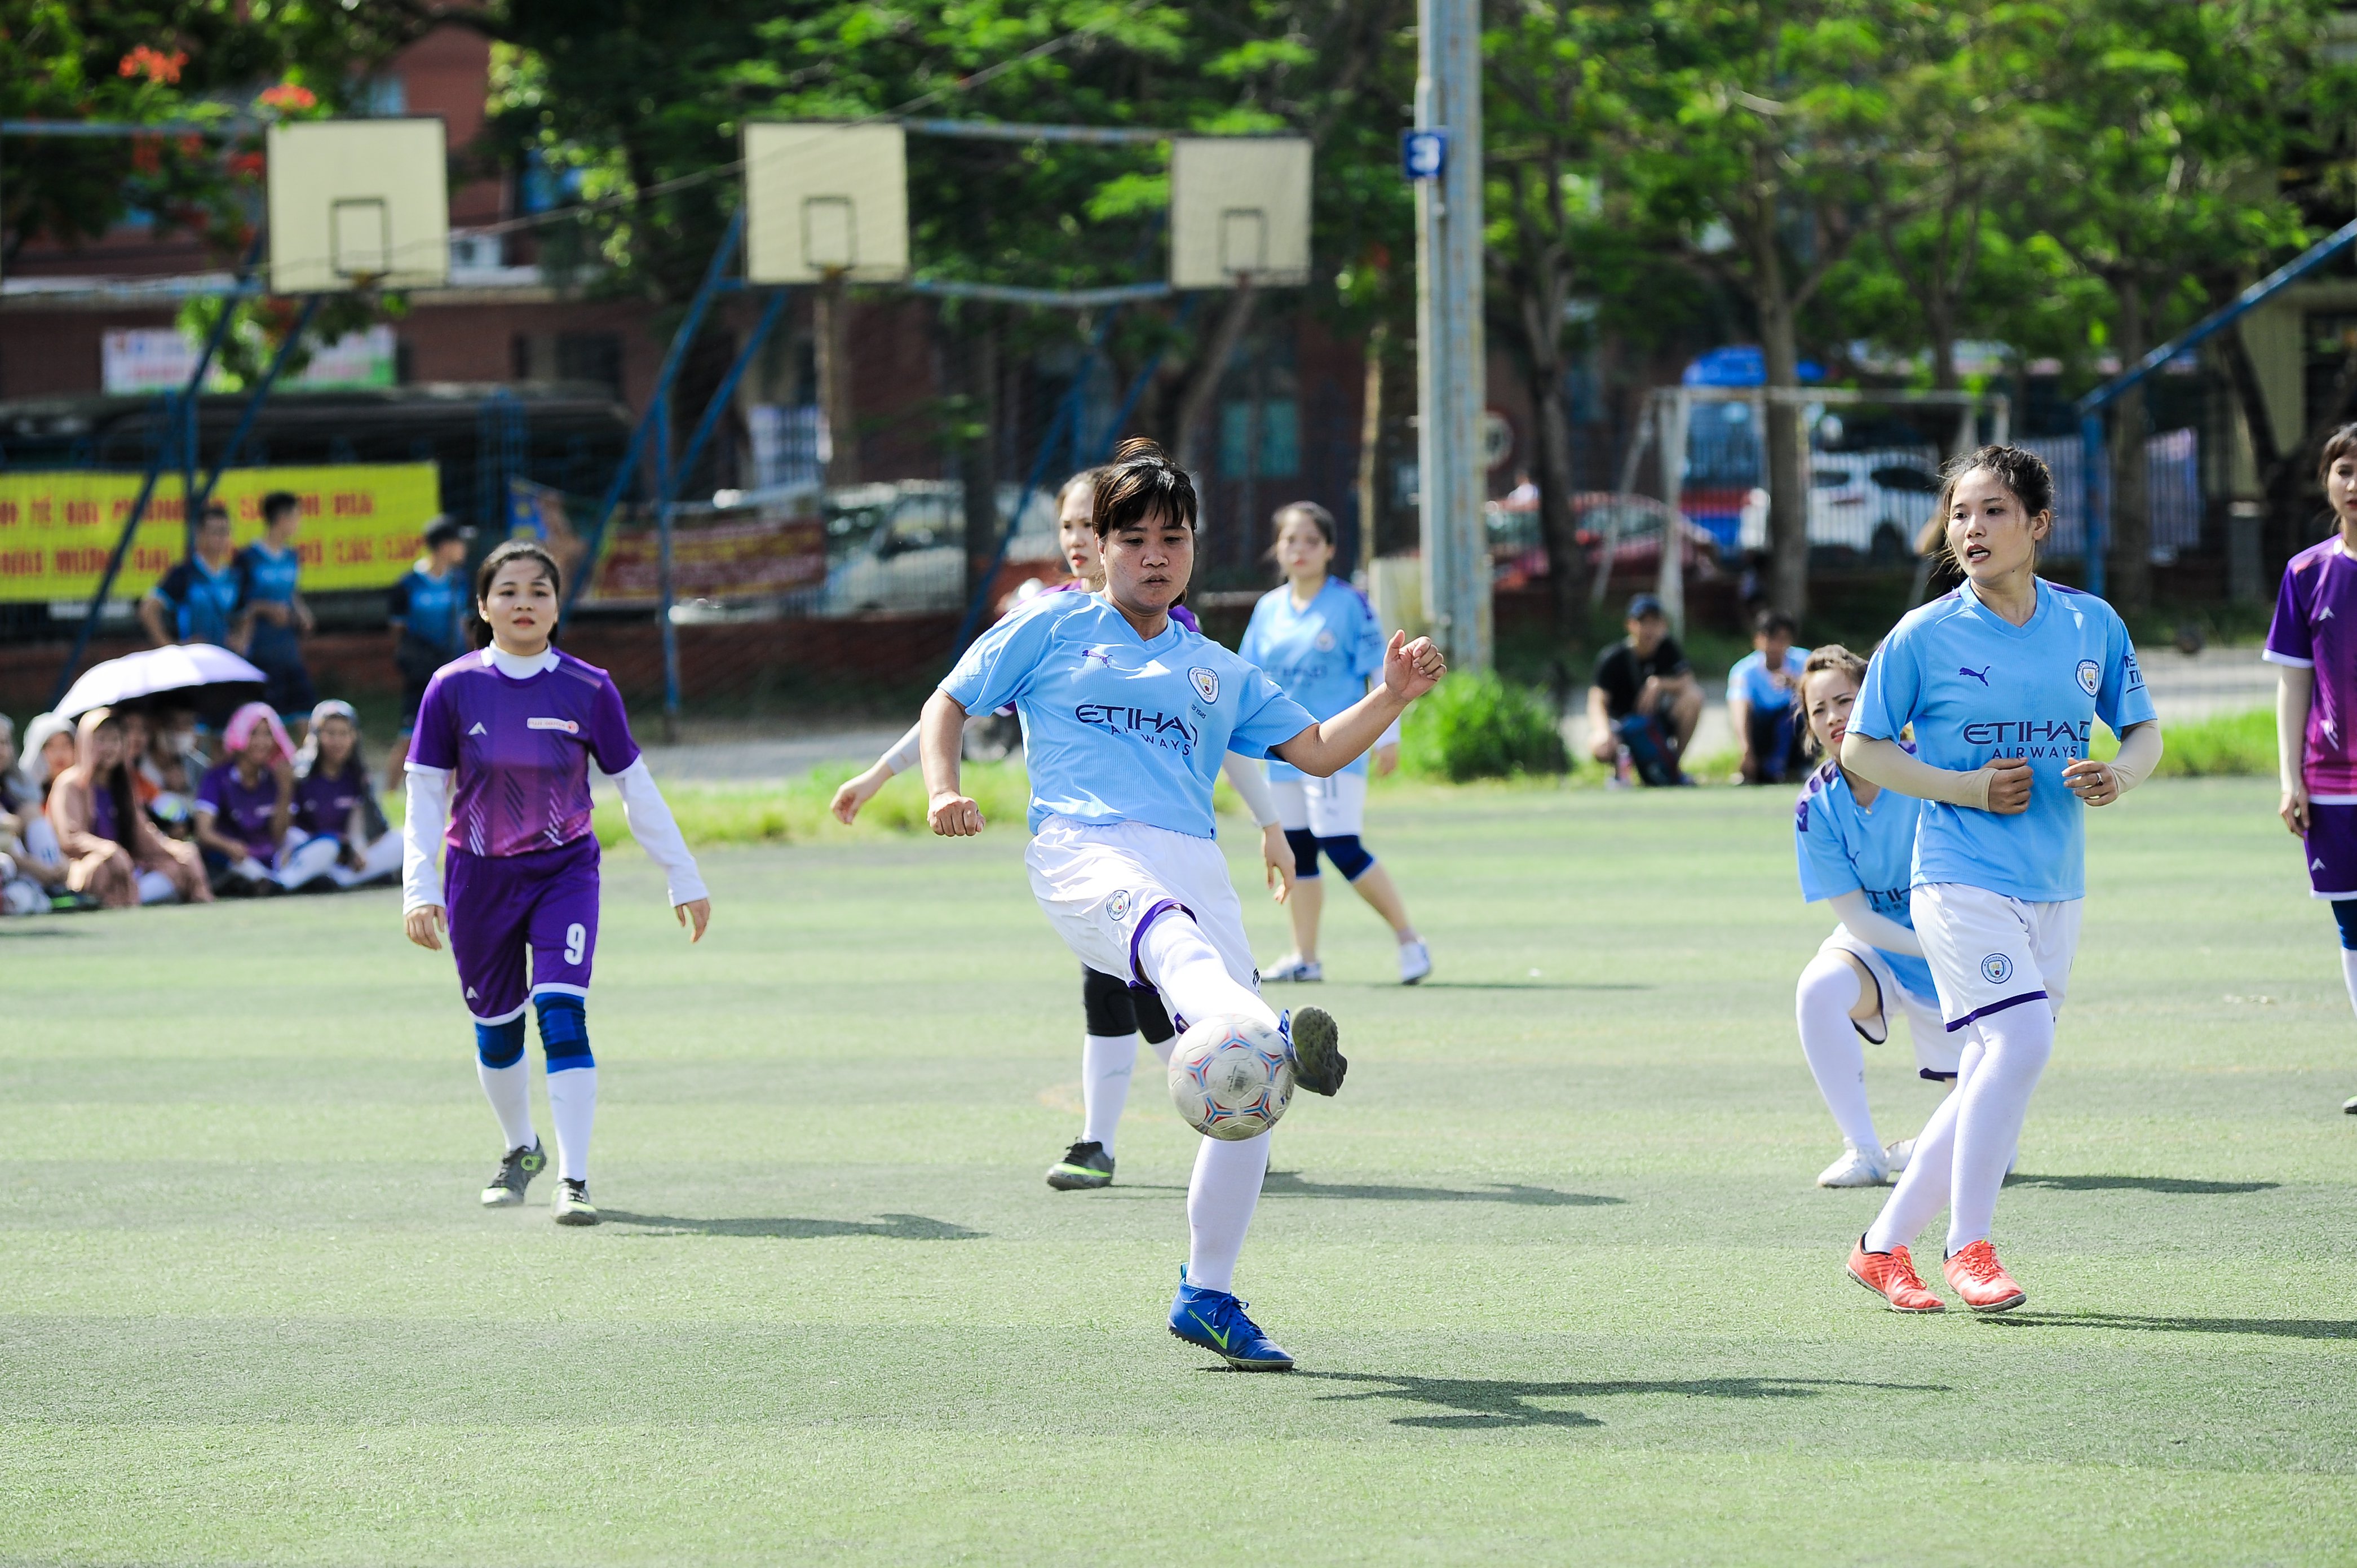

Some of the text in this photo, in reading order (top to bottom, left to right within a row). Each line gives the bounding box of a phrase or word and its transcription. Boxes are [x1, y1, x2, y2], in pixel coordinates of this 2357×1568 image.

[1410, 135, 1440, 172] 3
[1992, 746, 2078, 759] AIRWAYS
[564, 923, 586, 965] 9
